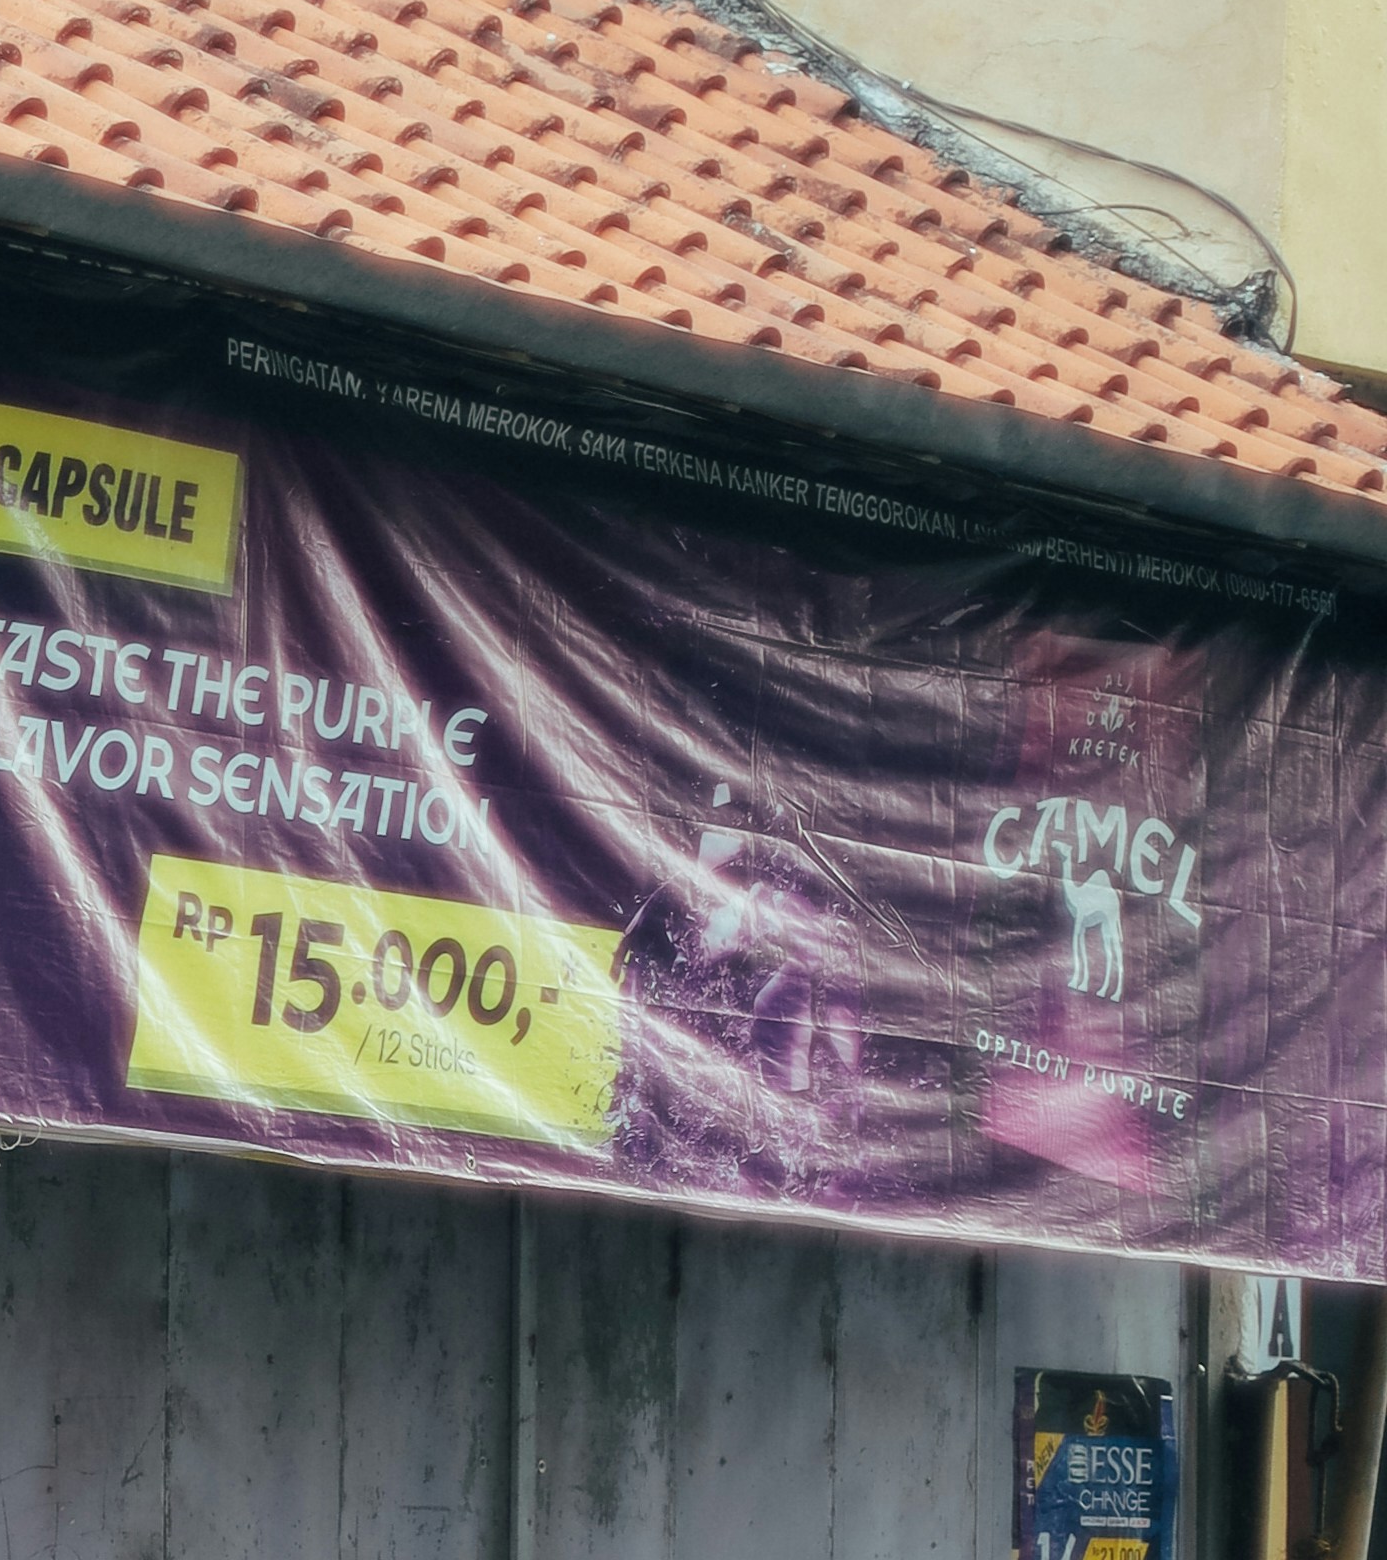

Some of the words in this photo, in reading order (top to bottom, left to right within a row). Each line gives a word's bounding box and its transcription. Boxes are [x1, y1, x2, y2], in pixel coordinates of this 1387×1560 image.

[466, 401, 573, 457] MEROKOK,
[578, 429, 628, 465] SAYA
[633, 441, 724, 487] TERKENA
[727, 468, 808, 506] KANKER
[1045, 536, 1133, 576] BERHENTI
[1137, 553, 1222, 593] MEROKOK
[162, 649, 269, 727] THE
[281, 673, 488, 767] PURPLE
[1068, 737, 1141, 768] KRETEK
[188, 746, 491, 853] SENSATION
[983, 796, 1202, 928] CAMEL
[408, 1034, 478, 1074] Sticks
[976, 1029, 1071, 1081] OPTION
[1084, 1069, 1194, 1120] PURPLE
[1035, 1440, 1055, 1476] NEW
[1091, 1446, 1152, 1485] ESSE
[1080, 1489, 1150, 1518] CHANGE
